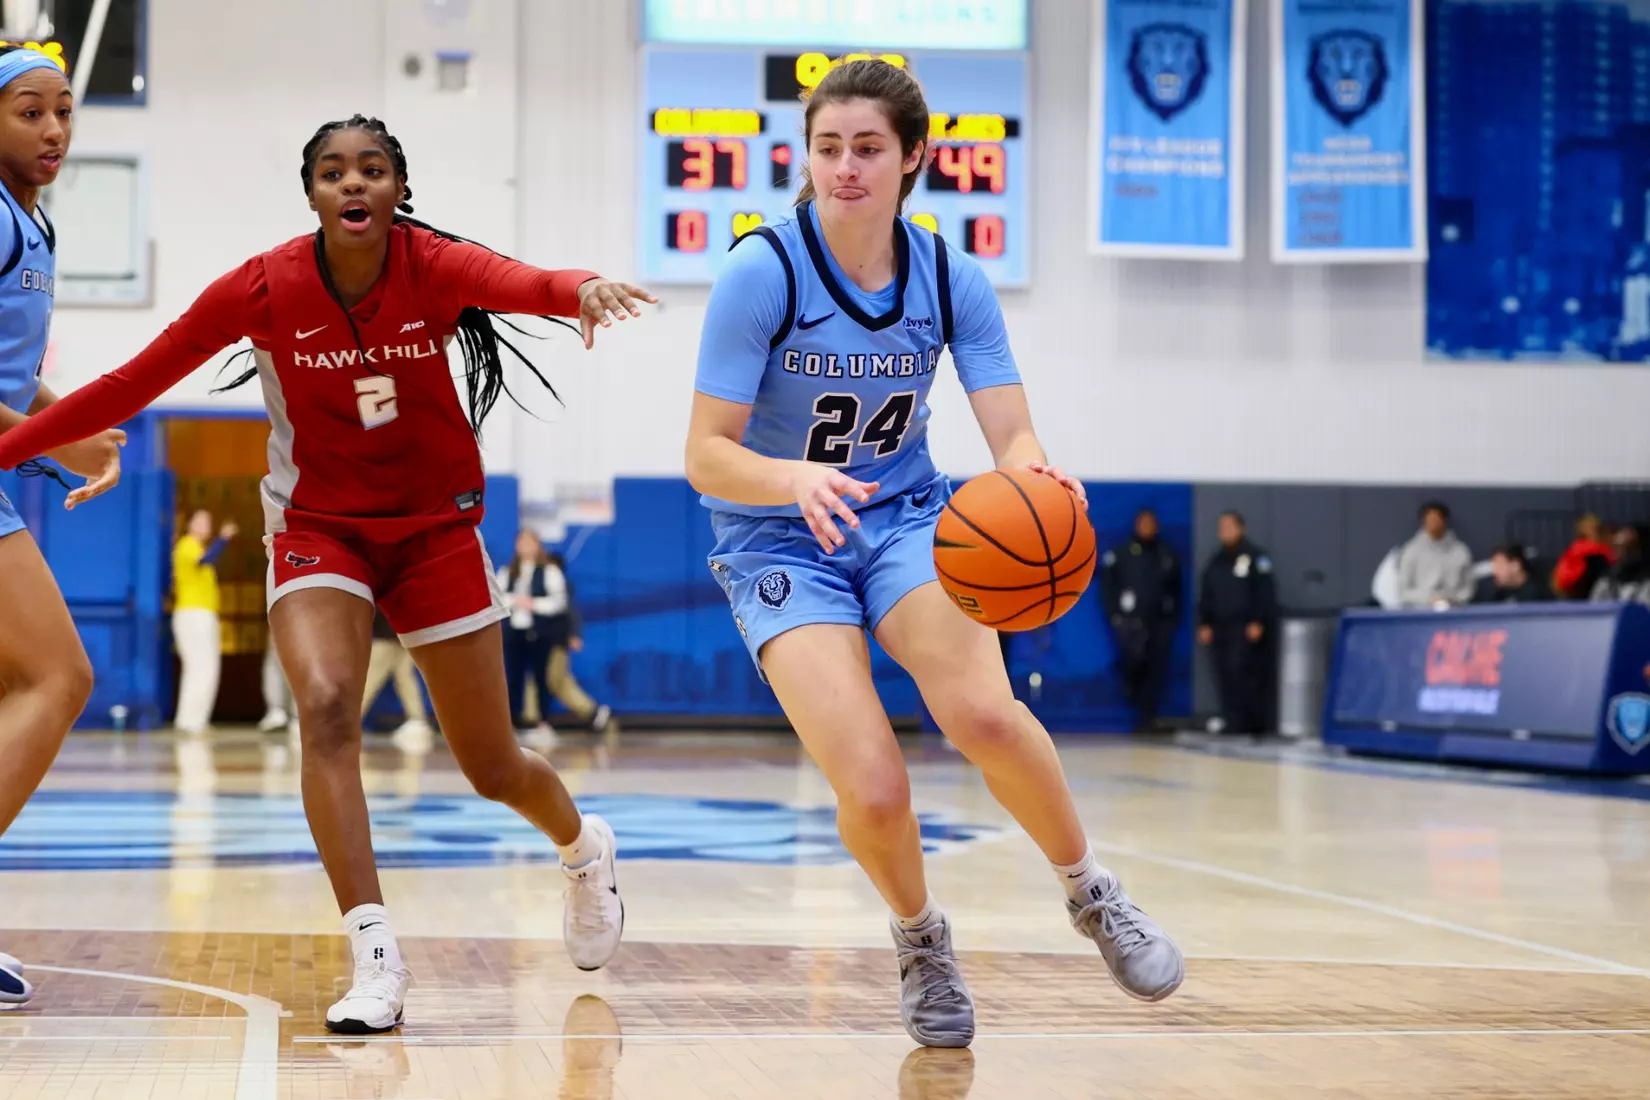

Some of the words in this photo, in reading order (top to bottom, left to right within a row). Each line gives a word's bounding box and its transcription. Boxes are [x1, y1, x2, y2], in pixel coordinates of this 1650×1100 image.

[682, 138, 748, 191] 37
[937, 143, 1005, 193] 49
[676, 211, 707, 253] 0
[974, 215, 1005, 257] 0
[293, 346, 379, 370] HAWK
[382, 339, 438, 361] HILL
[783, 348, 938, 379] COLUMBIA
[353, 374, 399, 430] 2
[802, 390, 917, 467] 24
